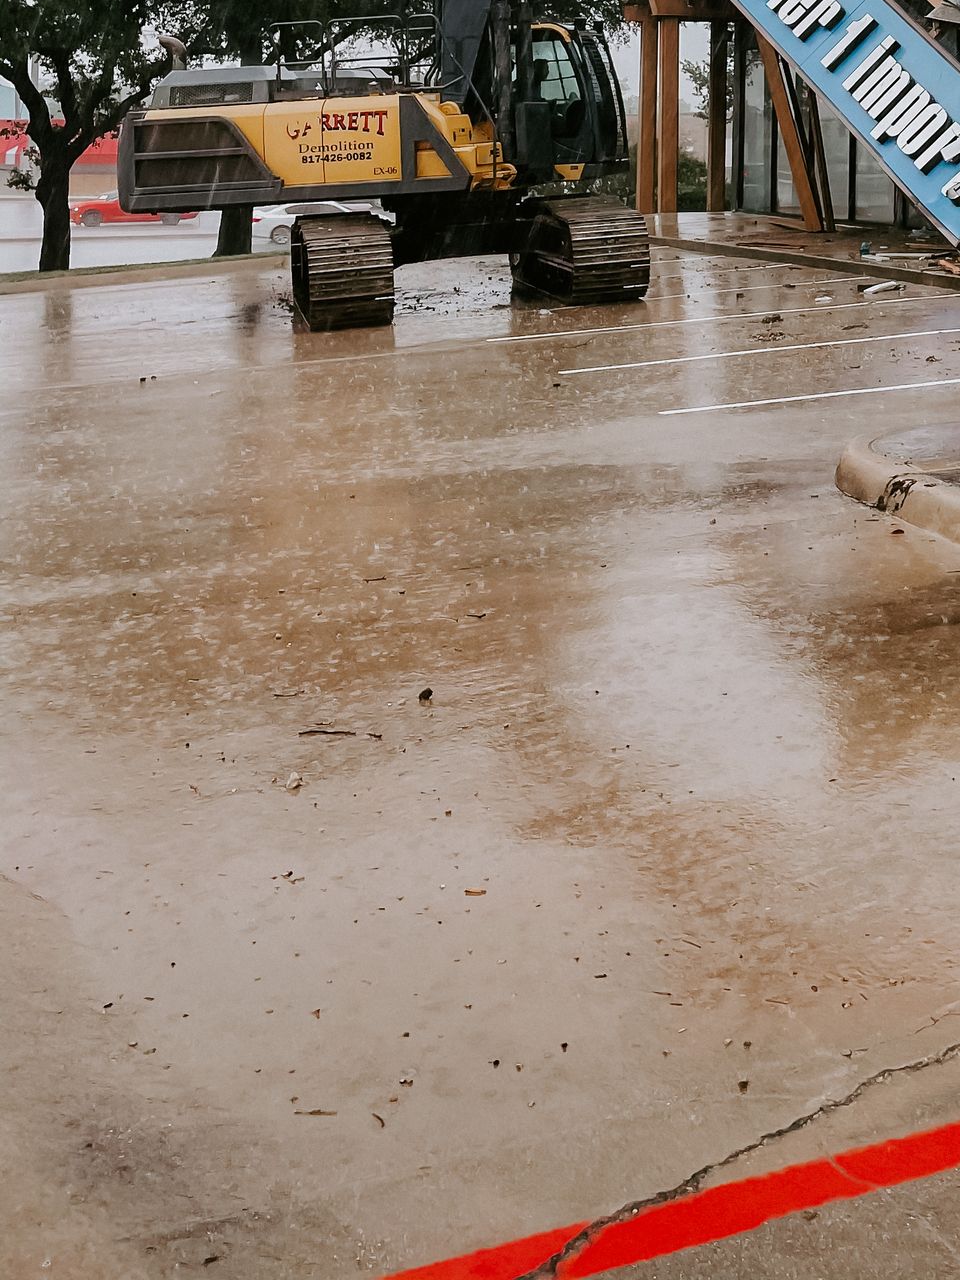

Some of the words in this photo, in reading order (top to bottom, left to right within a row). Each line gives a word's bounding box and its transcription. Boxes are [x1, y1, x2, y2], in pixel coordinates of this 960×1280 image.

[819, 13, 879, 72] 1
[299, 140, 374, 153] Demolition
[301, 151, 372, 164] 817-426-0082
[373, 166, 398, 176] EX-06
